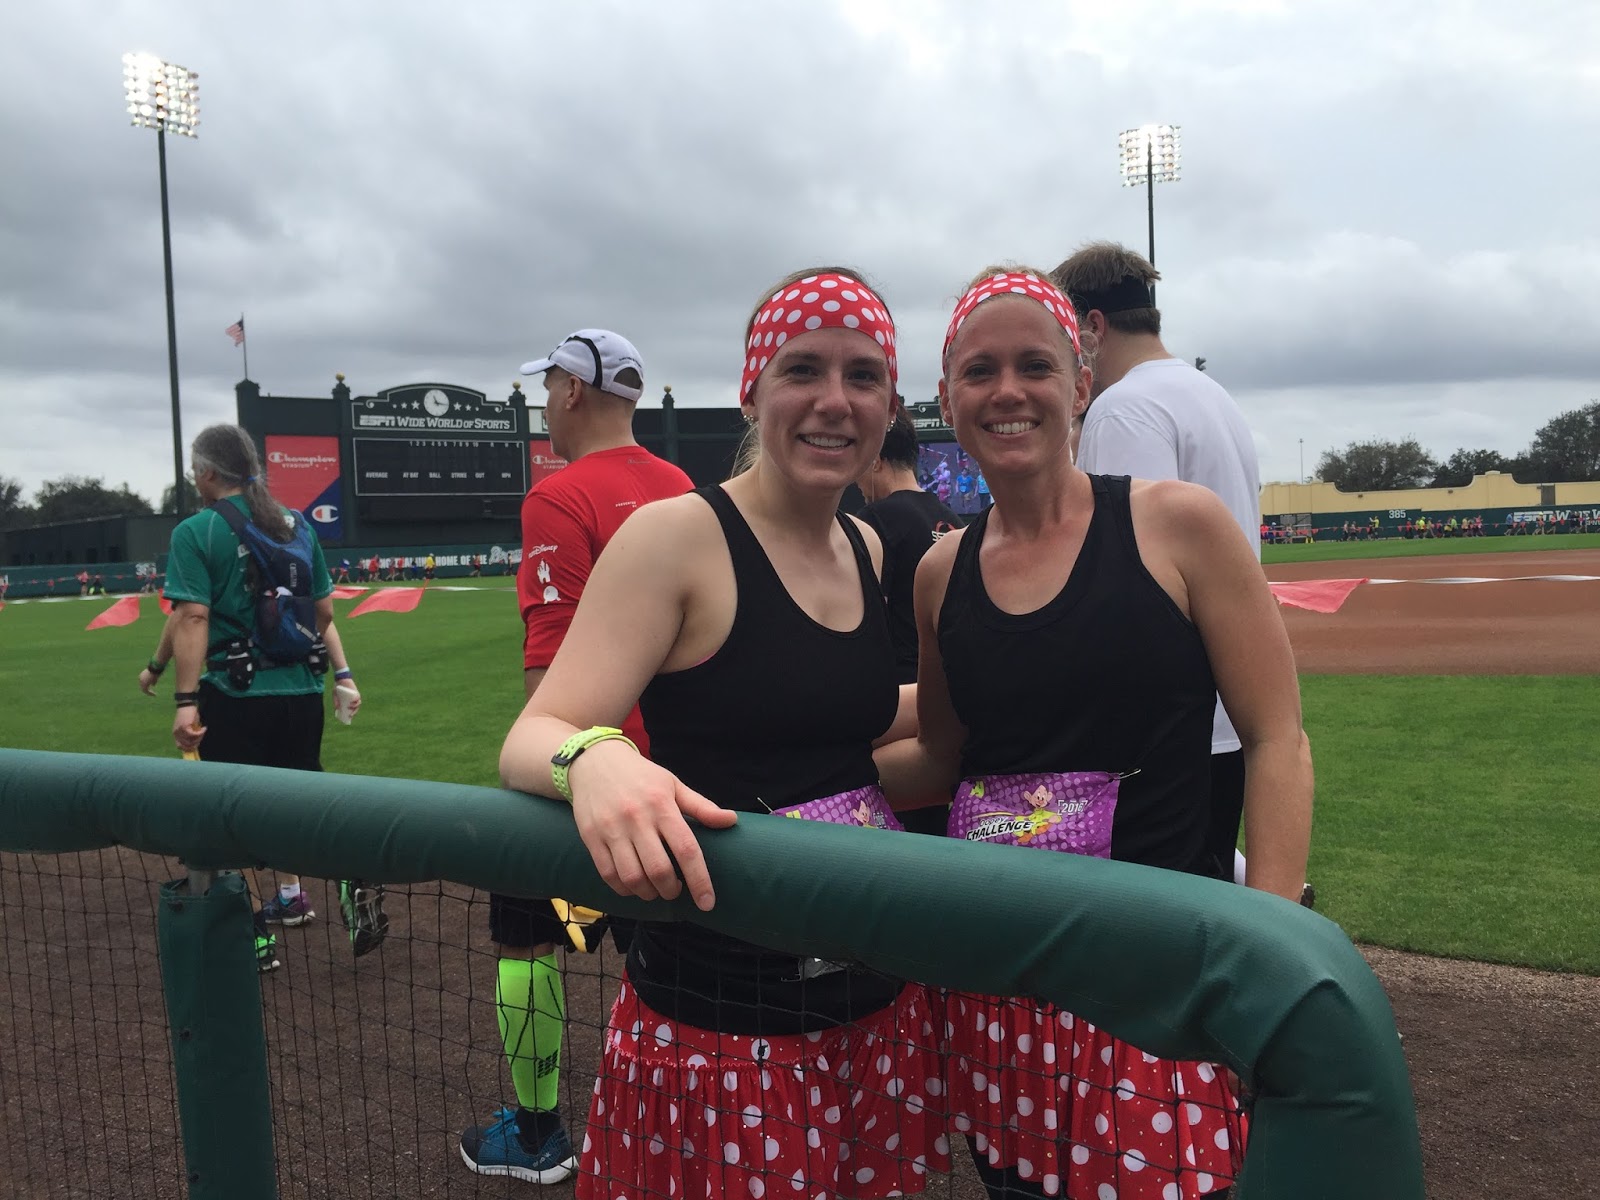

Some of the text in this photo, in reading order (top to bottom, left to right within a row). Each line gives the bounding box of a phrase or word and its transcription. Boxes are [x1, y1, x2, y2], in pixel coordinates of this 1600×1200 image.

[360, 415, 511, 429] ESPN WIDE WORLD OF SPORTS
[268, 451, 337, 465] Champion
[532, 454, 569, 467] Champ
[1388, 509, 1406, 519] 385
[435, 554, 459, 566] HOME
[461, 554, 471, 566] OF
[966, 820, 1033, 841] CHALLENGE
